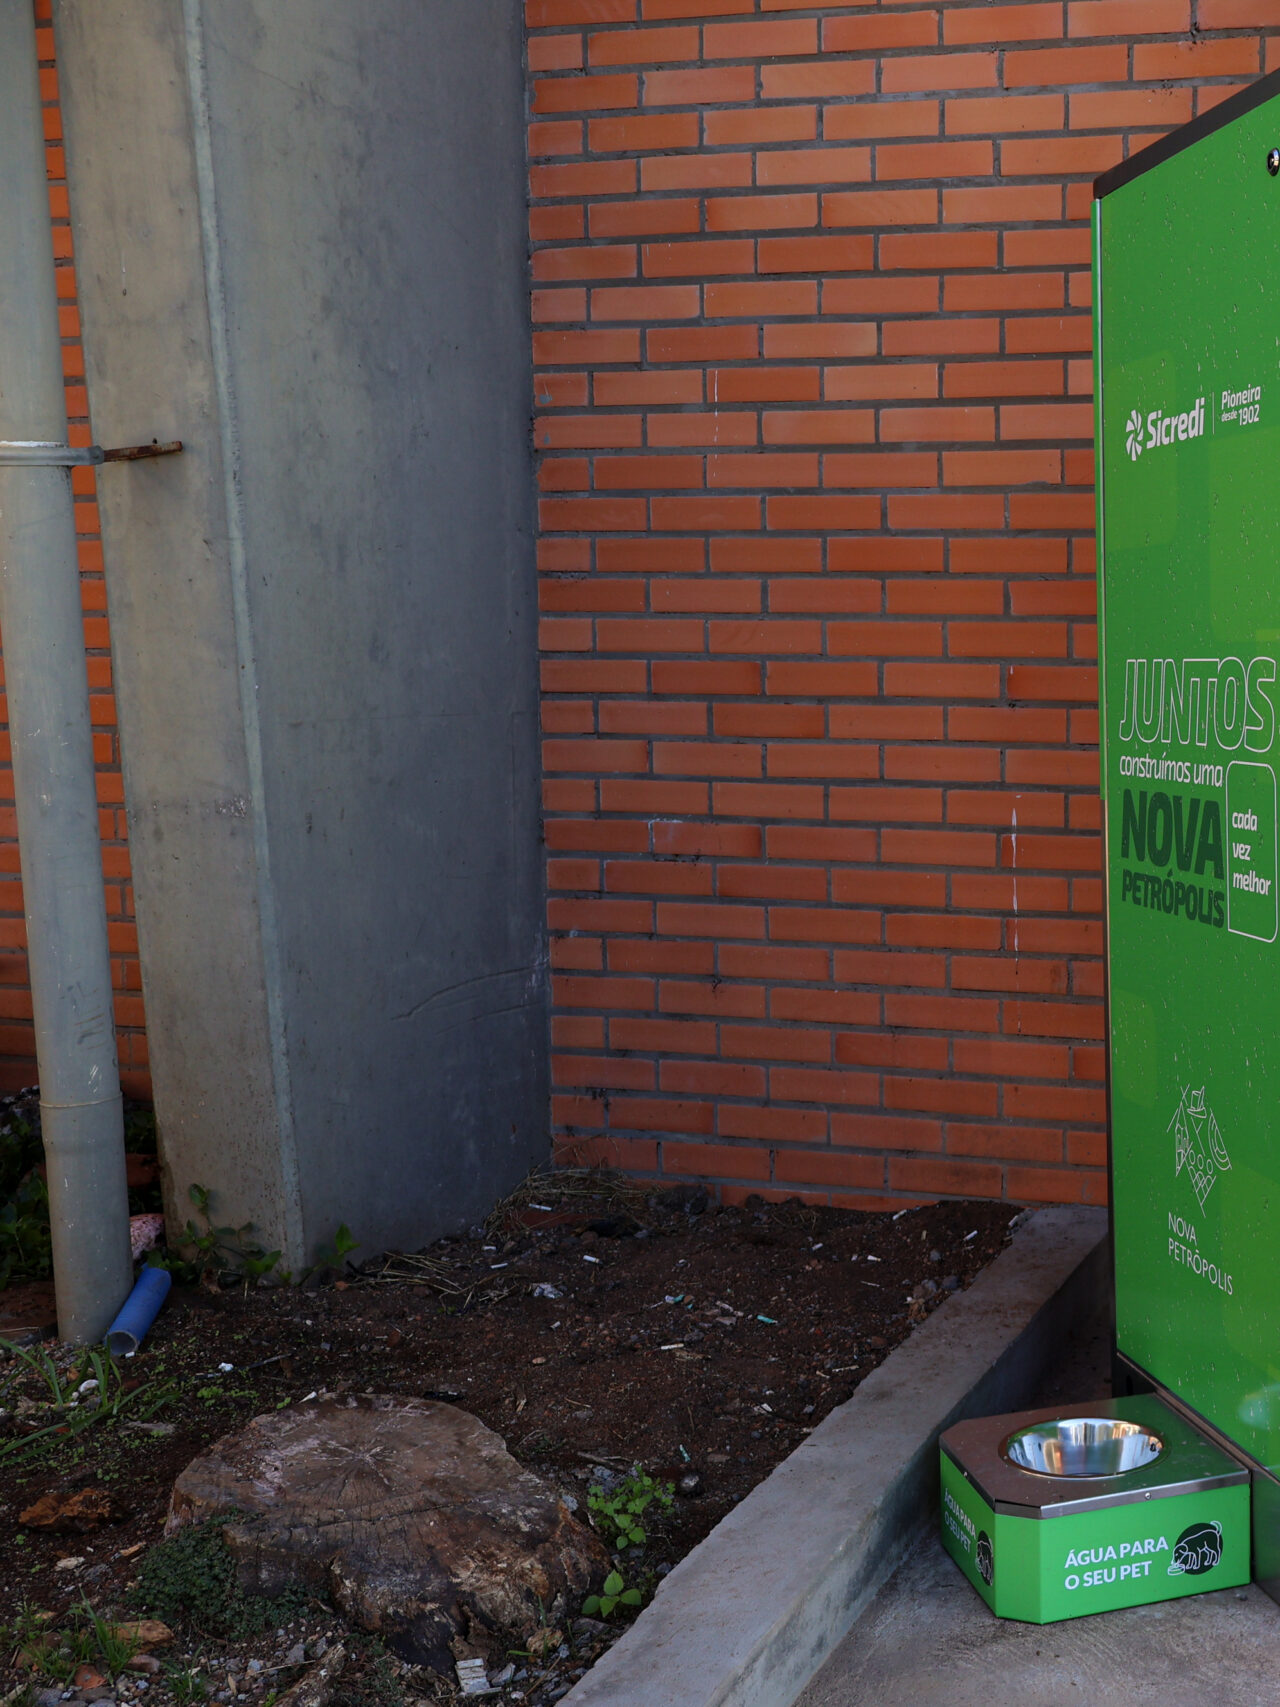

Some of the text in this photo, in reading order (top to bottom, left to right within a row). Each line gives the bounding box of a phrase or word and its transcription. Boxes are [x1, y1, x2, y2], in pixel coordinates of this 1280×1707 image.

[1221, 384, 1261, 410] Pioneira
[1146, 397, 1205, 449] Sicredi
[1221, 404, 1260, 426] desde 1902
[1119, 656, 1277, 753] JUNTOS
[1119, 751, 1223, 787] construímos uma
[1121, 788, 1225, 880] NOVA
[1232, 809, 1258, 832] cada
[1232, 842, 1251, 861] vez
[1122, 867, 1225, 929] PETRÓPOLIS
[1232, 870, 1271, 896] melhor
[1168, 1211, 1197, 1246] NOVA
[1168, 1237, 1233, 1296] PETRÓPOLIS
[944, 1487, 977, 1540] ÁGUA PARA
[950, 1517, 960, 1540] SEU
[960, 1530, 971, 1553] PET
[1064, 1536, 1169, 1569] ÁGUA PARA
[1064, 1560, 1153, 1590] O SEU PET
